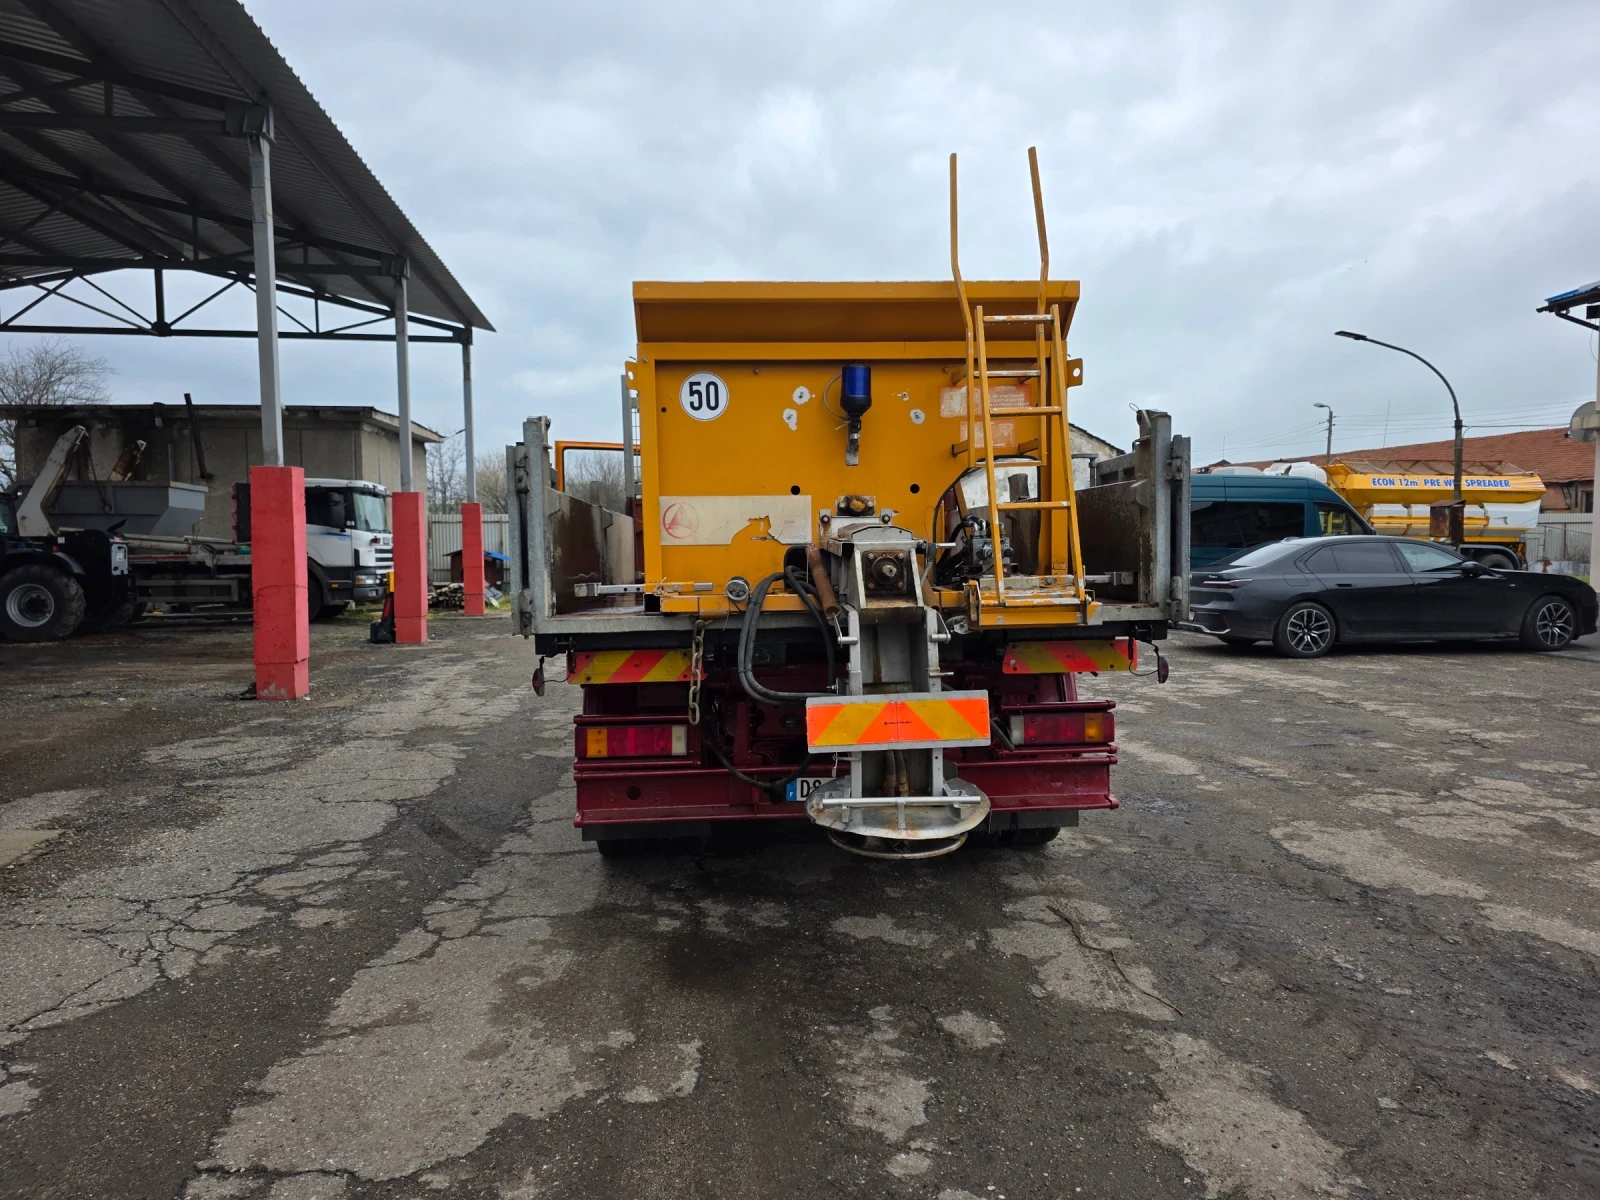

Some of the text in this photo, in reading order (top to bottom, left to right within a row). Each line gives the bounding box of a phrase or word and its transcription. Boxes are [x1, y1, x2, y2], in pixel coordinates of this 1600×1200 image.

[688, 380, 720, 412] 50
[1372, 477, 1396, 487] ECON
[1423, 478, 1442, 487] PRE
[1465, 479, 1511, 488] SPREADER
